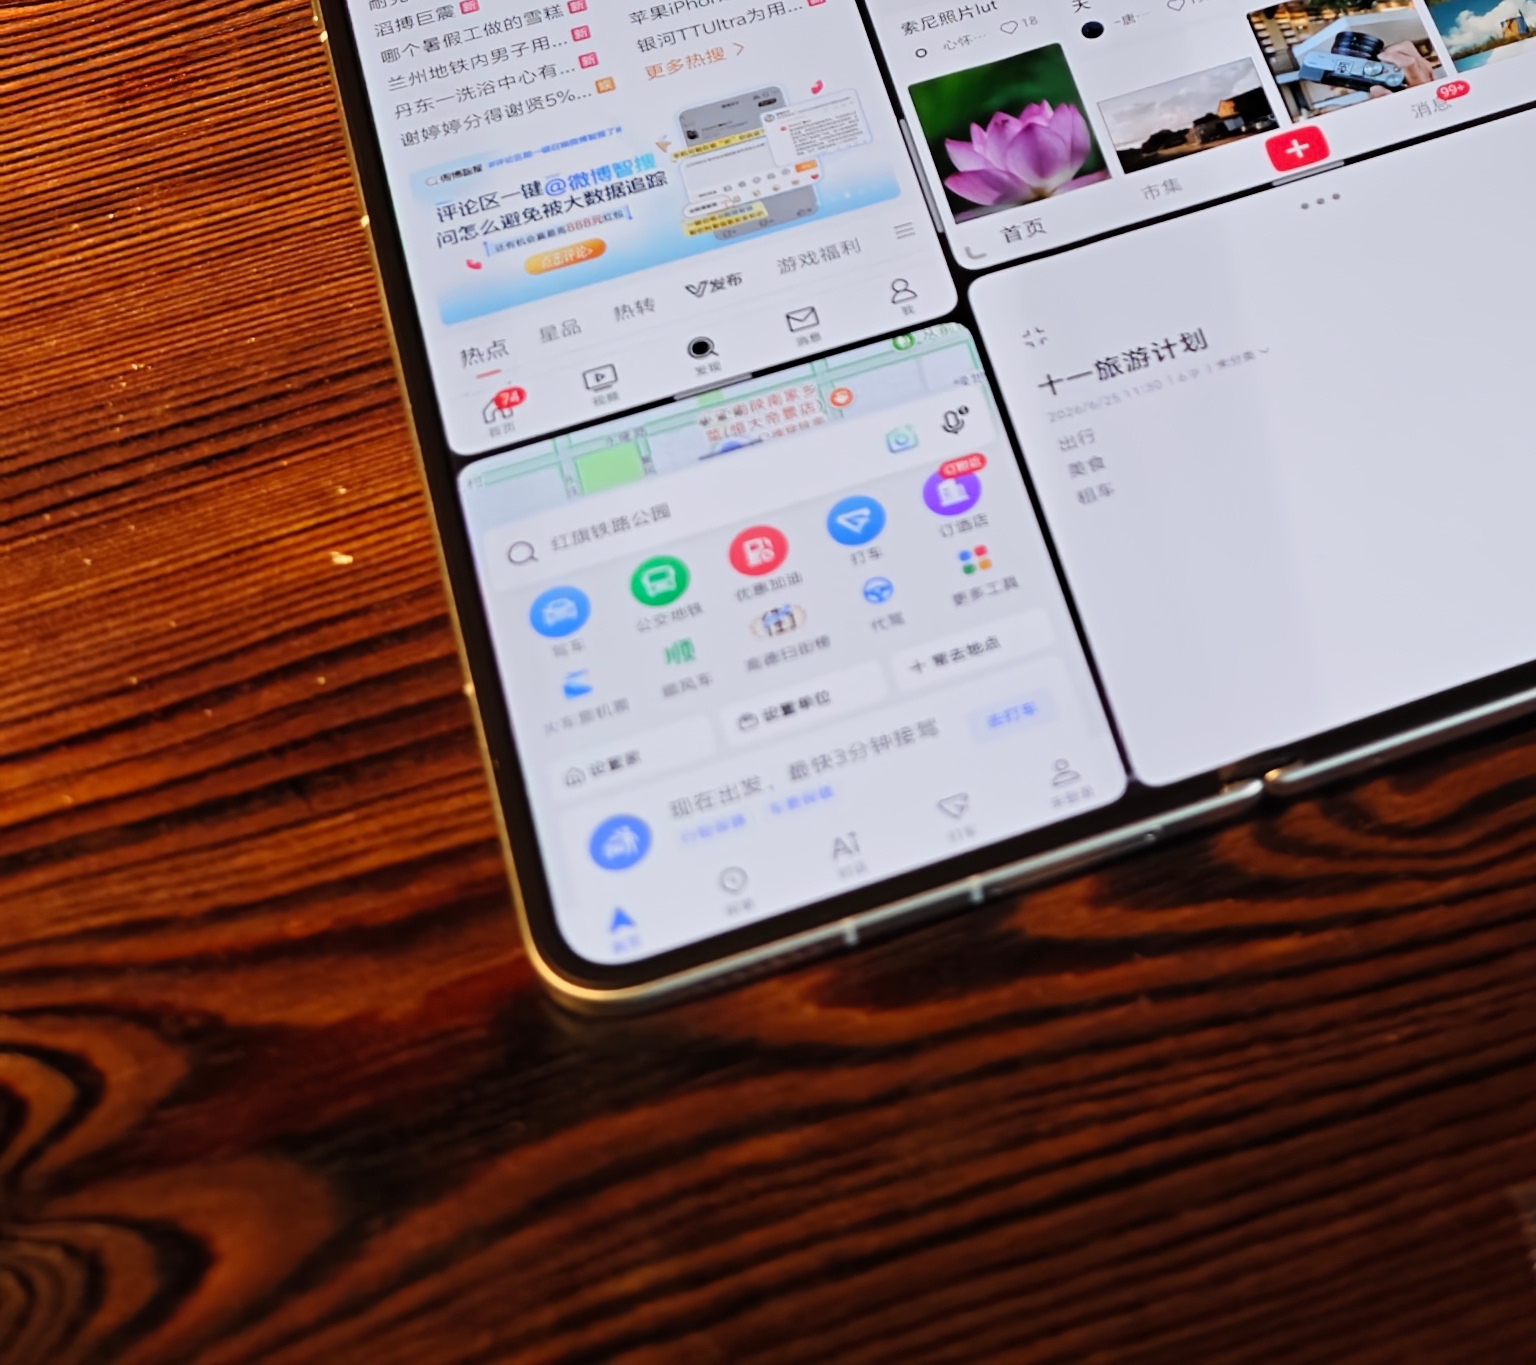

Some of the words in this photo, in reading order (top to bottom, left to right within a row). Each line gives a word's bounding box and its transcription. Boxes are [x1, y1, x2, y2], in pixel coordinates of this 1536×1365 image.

[381, 4, 564, 63] 哪个暑假工做的雪糕
[901, 0, 998, 36] 索尼照片lut
[1022, 16, 1038, 27] 18
[645, 47, 726, 81] 更多热搜
[1407, 92, 1453, 120] 消息
[1437, 80, 1469, 99] 99+
[435, 147, 659, 228] 评论区一键@微博智搜
[1140, 177, 1182, 201] 市集
[433, 168, 670, 250] 问怎么避免被大数据追踪
[1000, 218, 1047, 244] 首页
[777, 237, 861, 275] 游戏福利
[614, 296, 655, 322] 热转
[460, 338, 509, 368] 热点
[695, 361, 722, 376] 发现
[1037, 328, 1208, 397] 十一旅游计划
[497, 387, 521, 408] 74
[1058, 428, 1095, 452] 出行
[1067, 455, 1106, 478] 美食
[1076, 482, 1114, 505] 租车
[551, 503, 671, 551] 红旗铁路公园
[940, 513, 991, 537] 订酒店
[850, 546, 882, 565] 打车
[735, 571, 803, 602] 优惠加油
[952, 576, 1019, 607] 更多工具
[636, 602, 703, 633] 公交地铁
[763, 690, 830, 721] 设置单位
[666, 715, 943, 821] 现在出发，最快3分钟接驾
